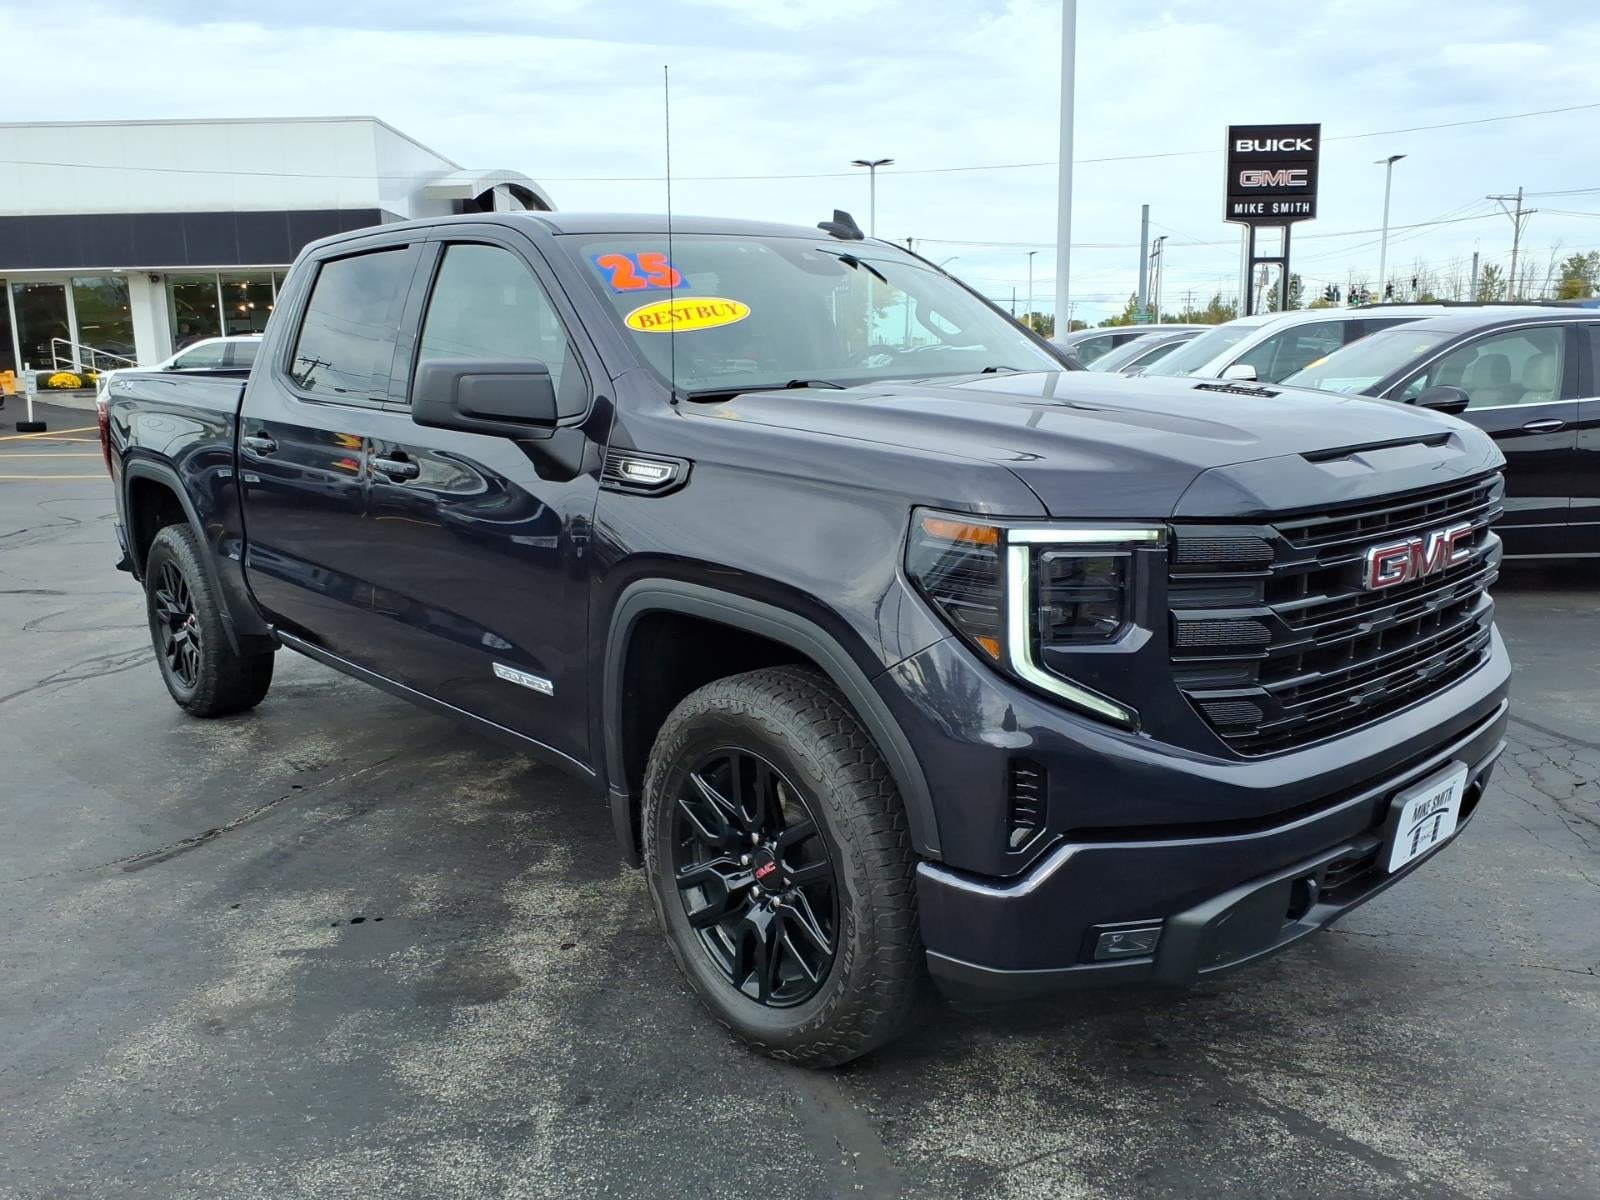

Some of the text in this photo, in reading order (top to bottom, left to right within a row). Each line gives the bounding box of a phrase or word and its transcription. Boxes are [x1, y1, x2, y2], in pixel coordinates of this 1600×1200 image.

[1236, 138, 1313, 152] BUICK
[1240, 169, 1308, 187] GMC
[1234, 202, 1310, 214] MIKE SMITH
[596, 252, 682, 290] 25
[638, 303, 738, 329] BEST BUY
[1362, 521, 1473, 591] GMC
[1412, 785, 1455, 822] MIKE SMITH
[755, 861, 776, 879] GMC
